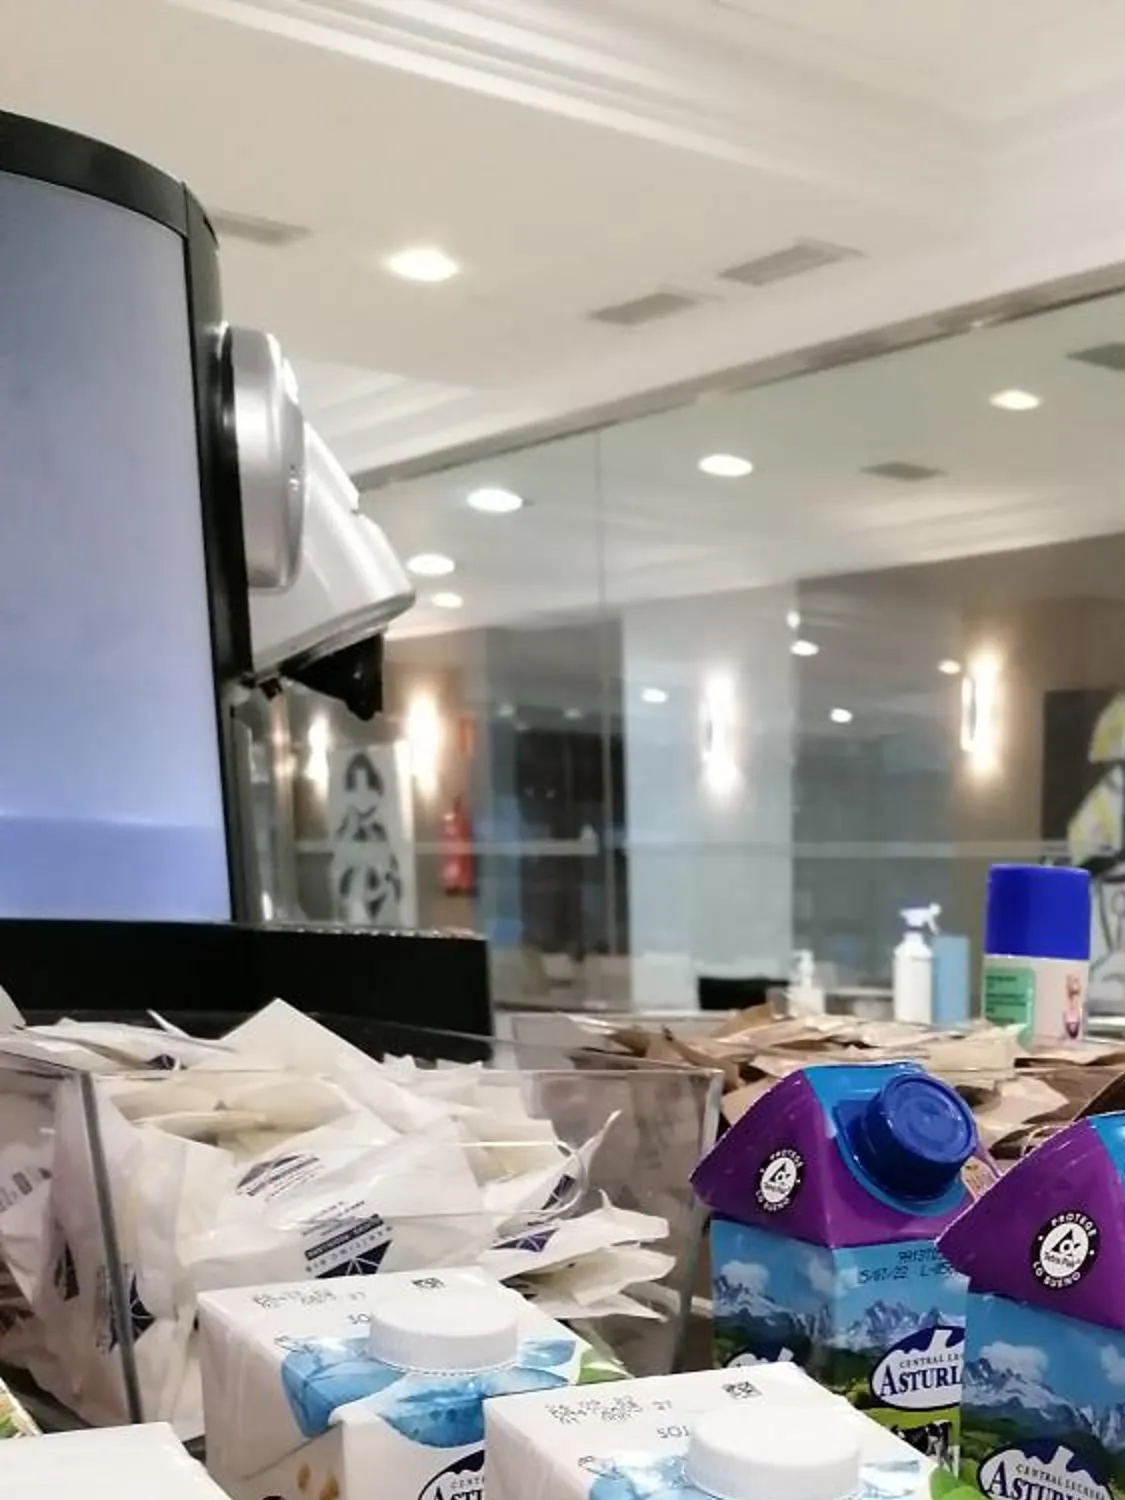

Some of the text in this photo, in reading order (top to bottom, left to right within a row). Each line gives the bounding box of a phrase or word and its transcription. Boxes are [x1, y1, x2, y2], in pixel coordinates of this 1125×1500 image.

[900, 1356, 944, 1370] CENTRAL
[450, 1474, 487, 1490] CENT
[1015, 1463, 1062, 1489] CENTRAL
